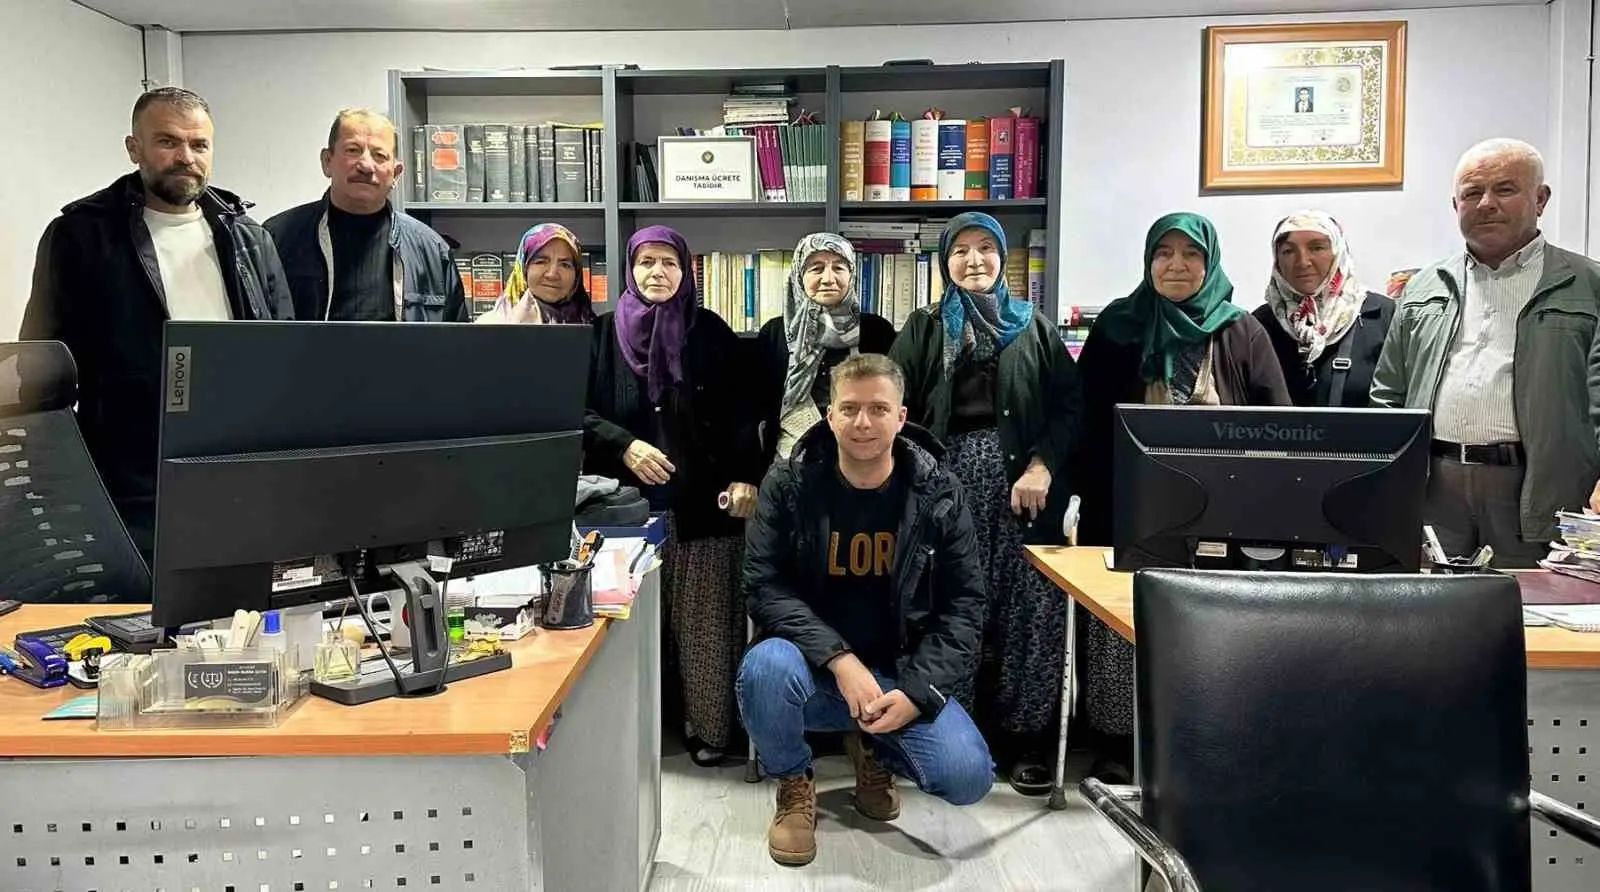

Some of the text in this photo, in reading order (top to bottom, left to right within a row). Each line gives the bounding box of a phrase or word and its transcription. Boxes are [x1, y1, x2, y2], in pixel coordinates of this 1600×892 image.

[171, 352, 186, 406] Lenovo
[1211, 421, 1325, 441] ViewSonic
[828, 531, 896, 576] LOR
